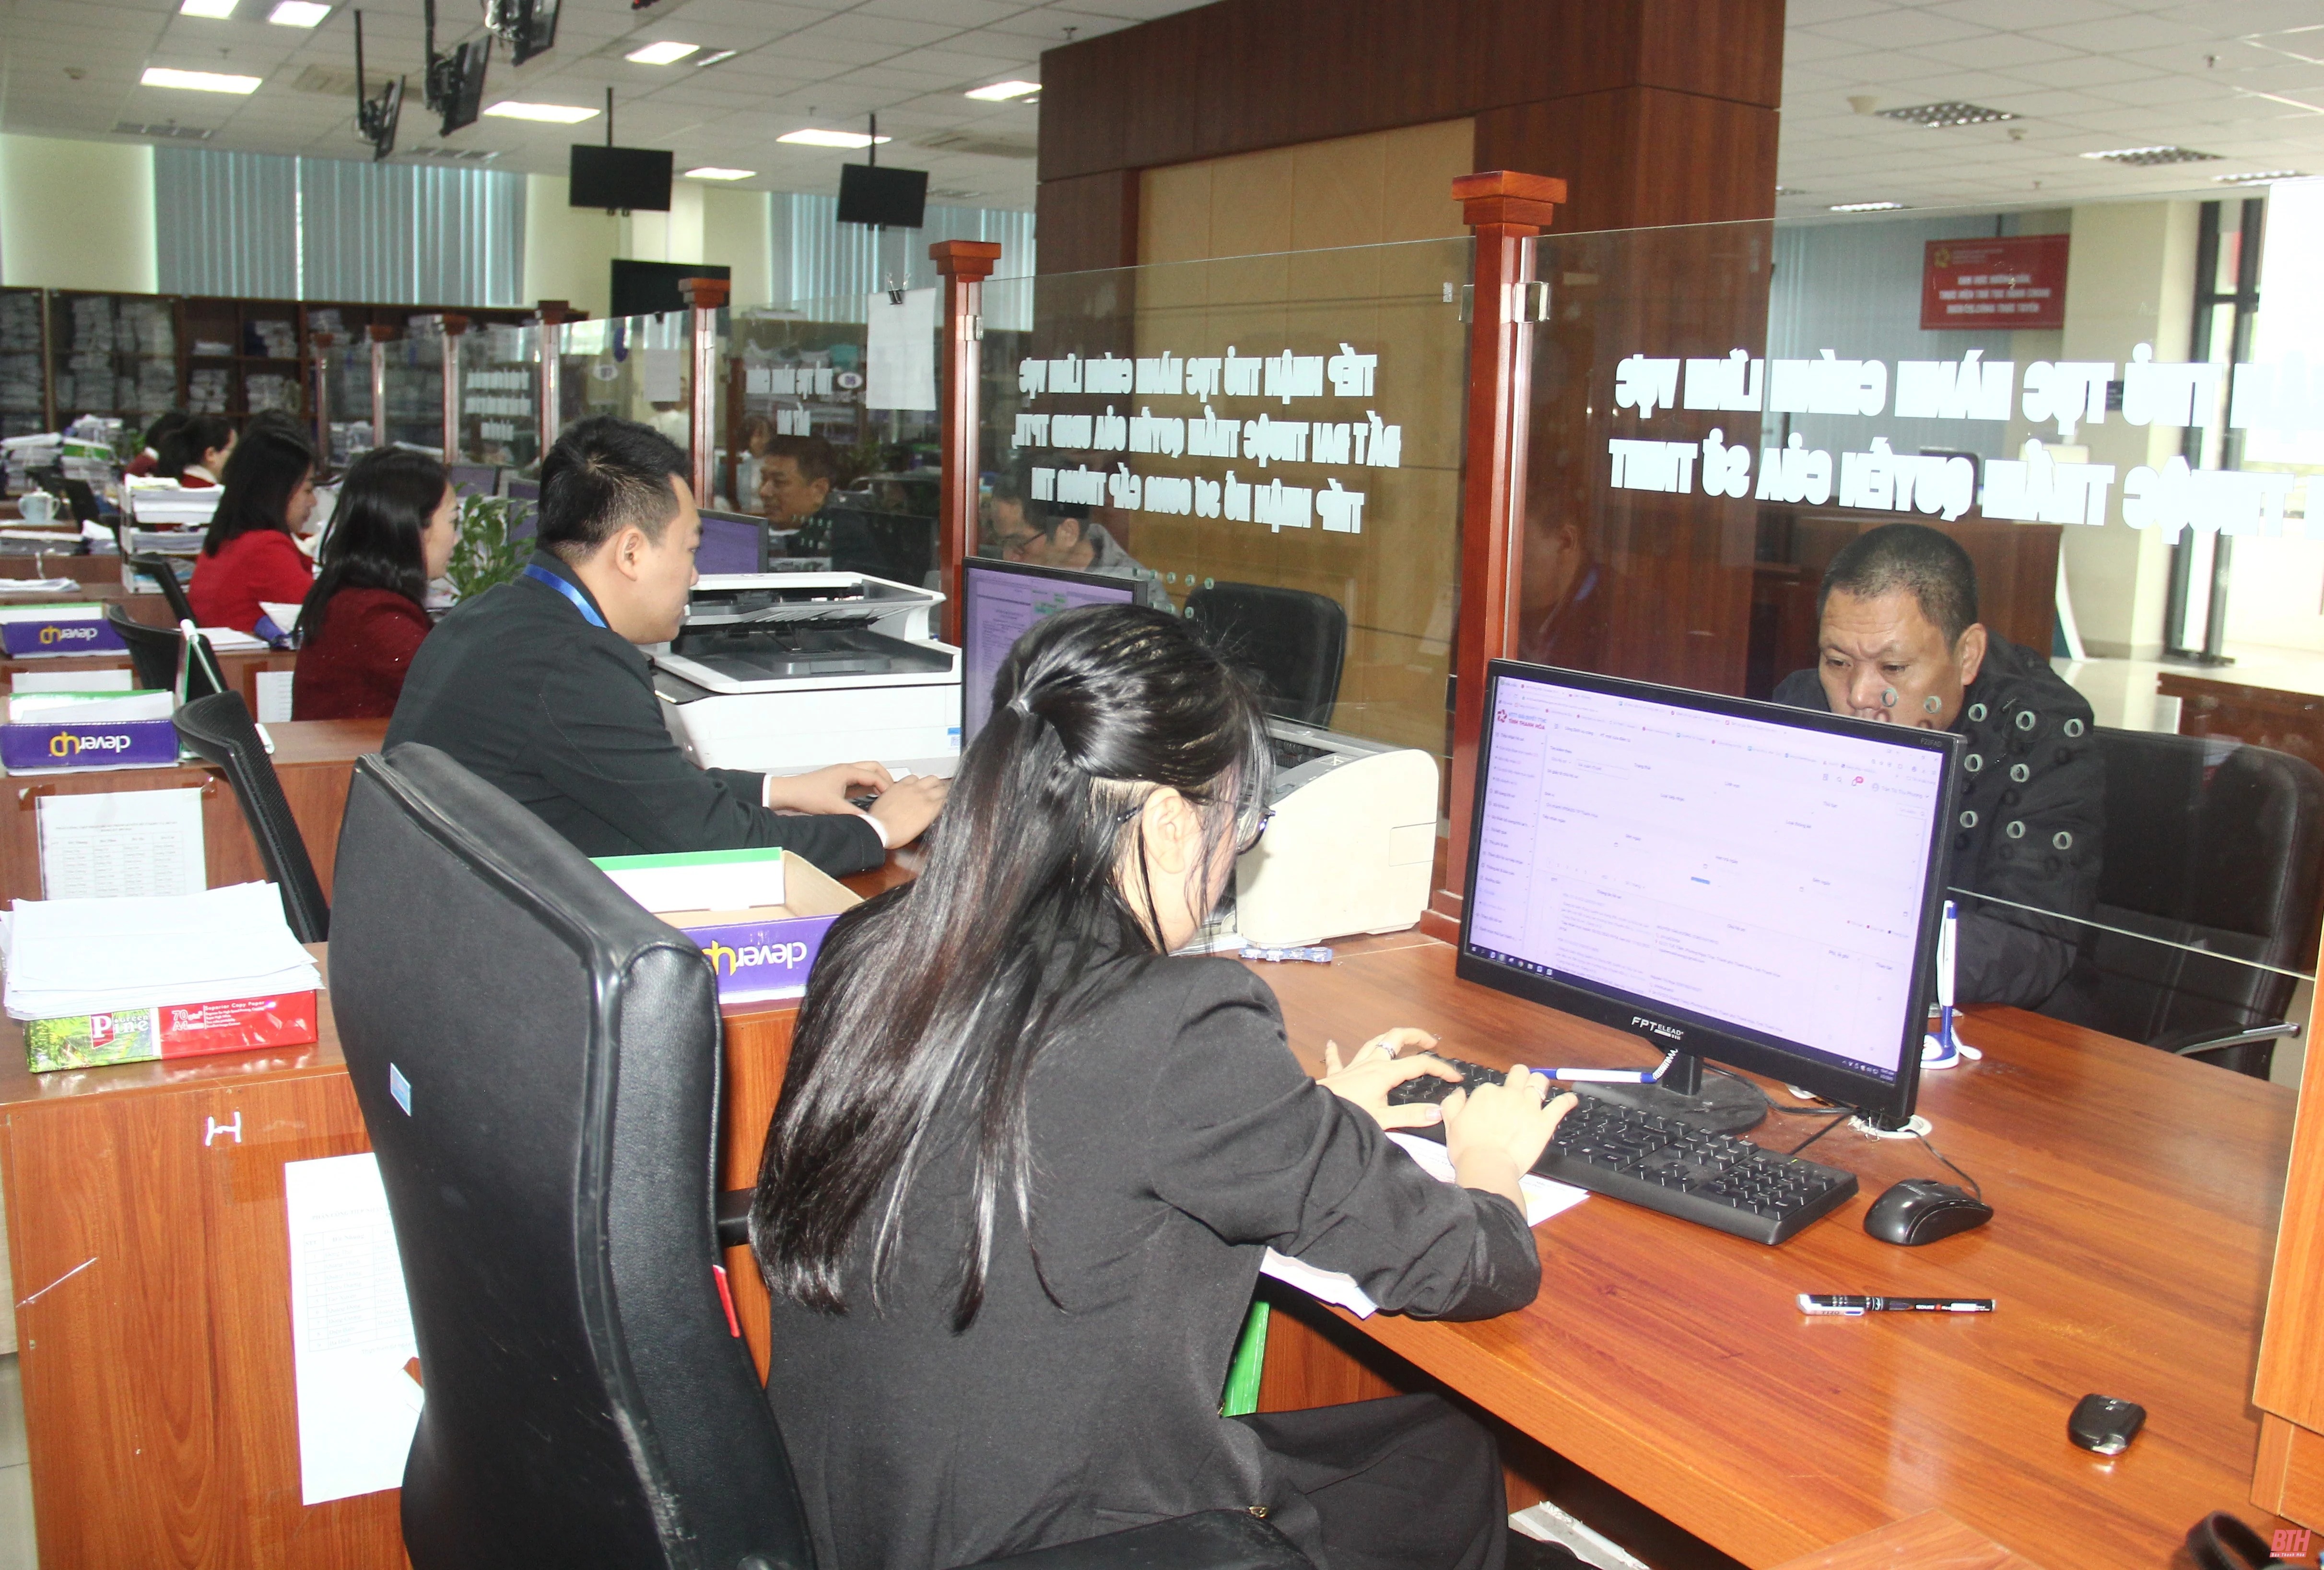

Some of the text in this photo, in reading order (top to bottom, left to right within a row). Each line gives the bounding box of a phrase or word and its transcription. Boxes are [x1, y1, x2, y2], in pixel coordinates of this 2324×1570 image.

[92, 1015, 150, 1039] Pine
[172, 1020, 188, 1031] A4
[1631, 1015, 1657, 1032] FPT
